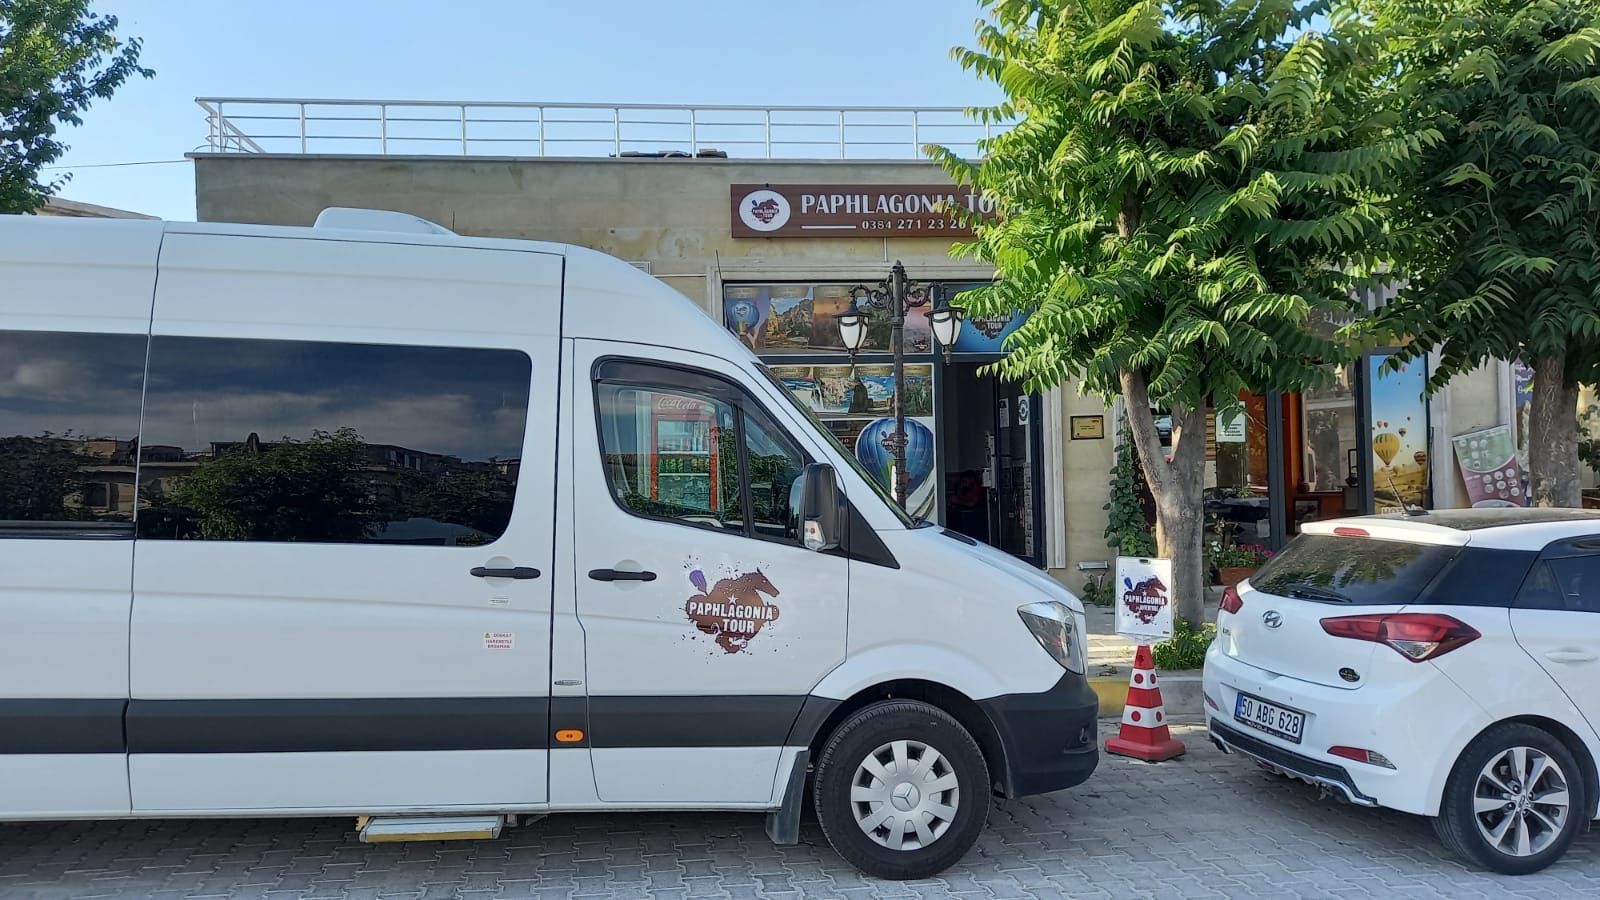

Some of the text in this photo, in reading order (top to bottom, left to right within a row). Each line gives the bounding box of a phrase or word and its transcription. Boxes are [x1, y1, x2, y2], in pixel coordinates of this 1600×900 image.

[801, 194, 957, 214] PAPHLAGONIA
[861, 220, 891, 230] 0384
[897, 219, 922, 230] 271
[927, 219, 945, 230] 23
[987, 322, 1003, 330] TOUR
[1125, 594, 1165, 606] PAPHLAGONIA
[688, 602, 774, 620] PAPHLAGONIA
[722, 619, 755, 633] TOUR
[1242, 698, 1253, 718] 50
[1256, 703, 1275, 726] ABG
[1278, 711, 1300, 735] 628
